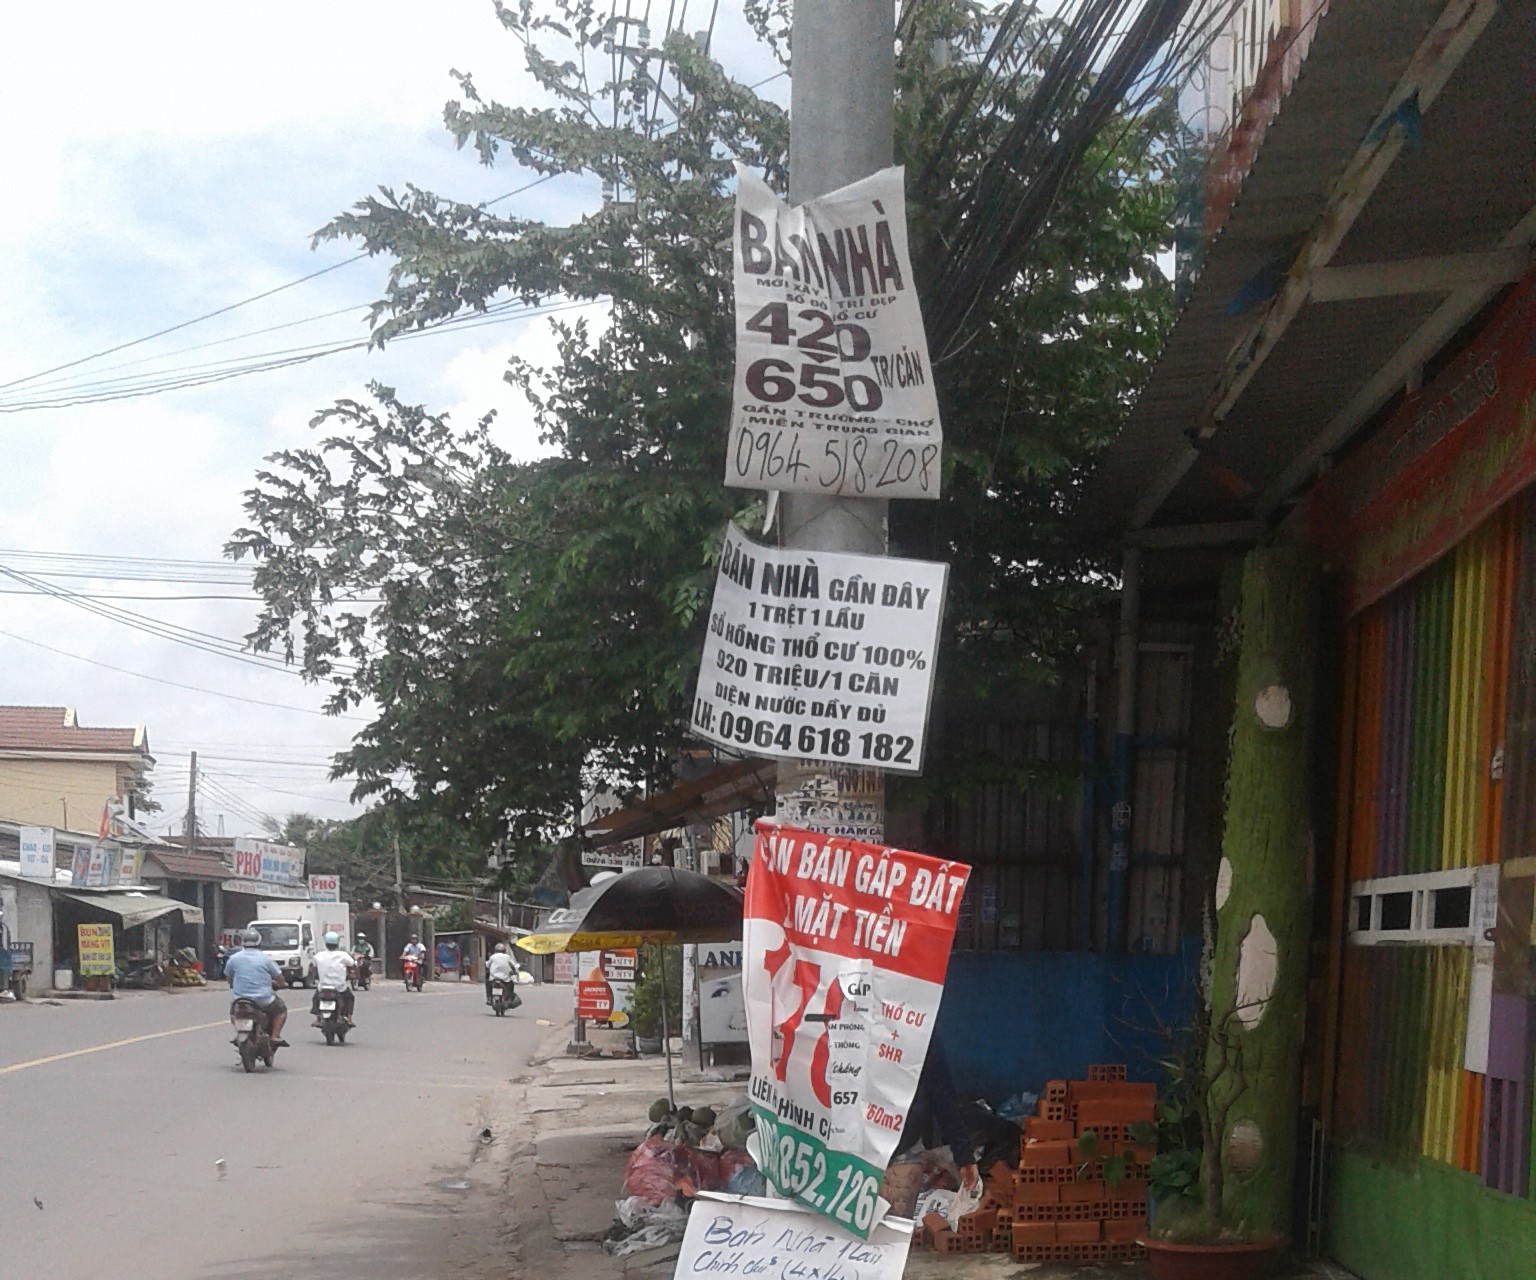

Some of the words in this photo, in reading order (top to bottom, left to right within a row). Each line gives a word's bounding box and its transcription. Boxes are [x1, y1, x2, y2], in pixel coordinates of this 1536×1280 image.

[817, 199, 905, 299] NHÀ
[746, 302, 871, 363] 420
[746, 358, 883, 412] 650
[876, 438, 938, 492] 208
[721, 539, 755, 591] BÁN
[760, 557, 820, 600] NHÀ
[828, 573, 876, 606] GẦN
[881, 581, 930, 610] ĐÂY
[710, 610, 727, 638] SỔ
[725, 623, 776, 655] HỒNG
[782, 631, 819, 659] THỔ
[824, 641, 860, 662] CƯ
[862, 645, 927, 671] 100%
[749, 602, 756, 619] 1
[762, 603, 807, 629] TRỆT
[811, 608, 820, 626] 1
[825, 607, 865, 631] LẦU
[716, 649, 748, 678] 920
[848, 672, 900, 697] CĂN
[715, 681, 751, 708] ĐIỆN
[755, 694, 806, 716] NƯỚC
[811, 699, 853, 720] ĐẦY
[857, 703, 887, 724] ĐỦ
[720, 711, 792, 752] 0964
[798, 726, 851, 764] 618
[859, 732, 915, 765] 182
[797, 838, 852, 888] BÁN
[854, 849, 907, 899] GẤP
[909, 861, 965, 914] ĐẤT
[794, 892, 850, 945] MẶT
[853, 903, 908, 958] TIỀN
[881, 1001, 904, 1021] THỔ
[905, 1010, 927, 1028] CƯ
[878, 1043, 903, 1063] SHR
[833, 1092, 859, 1105] 657
